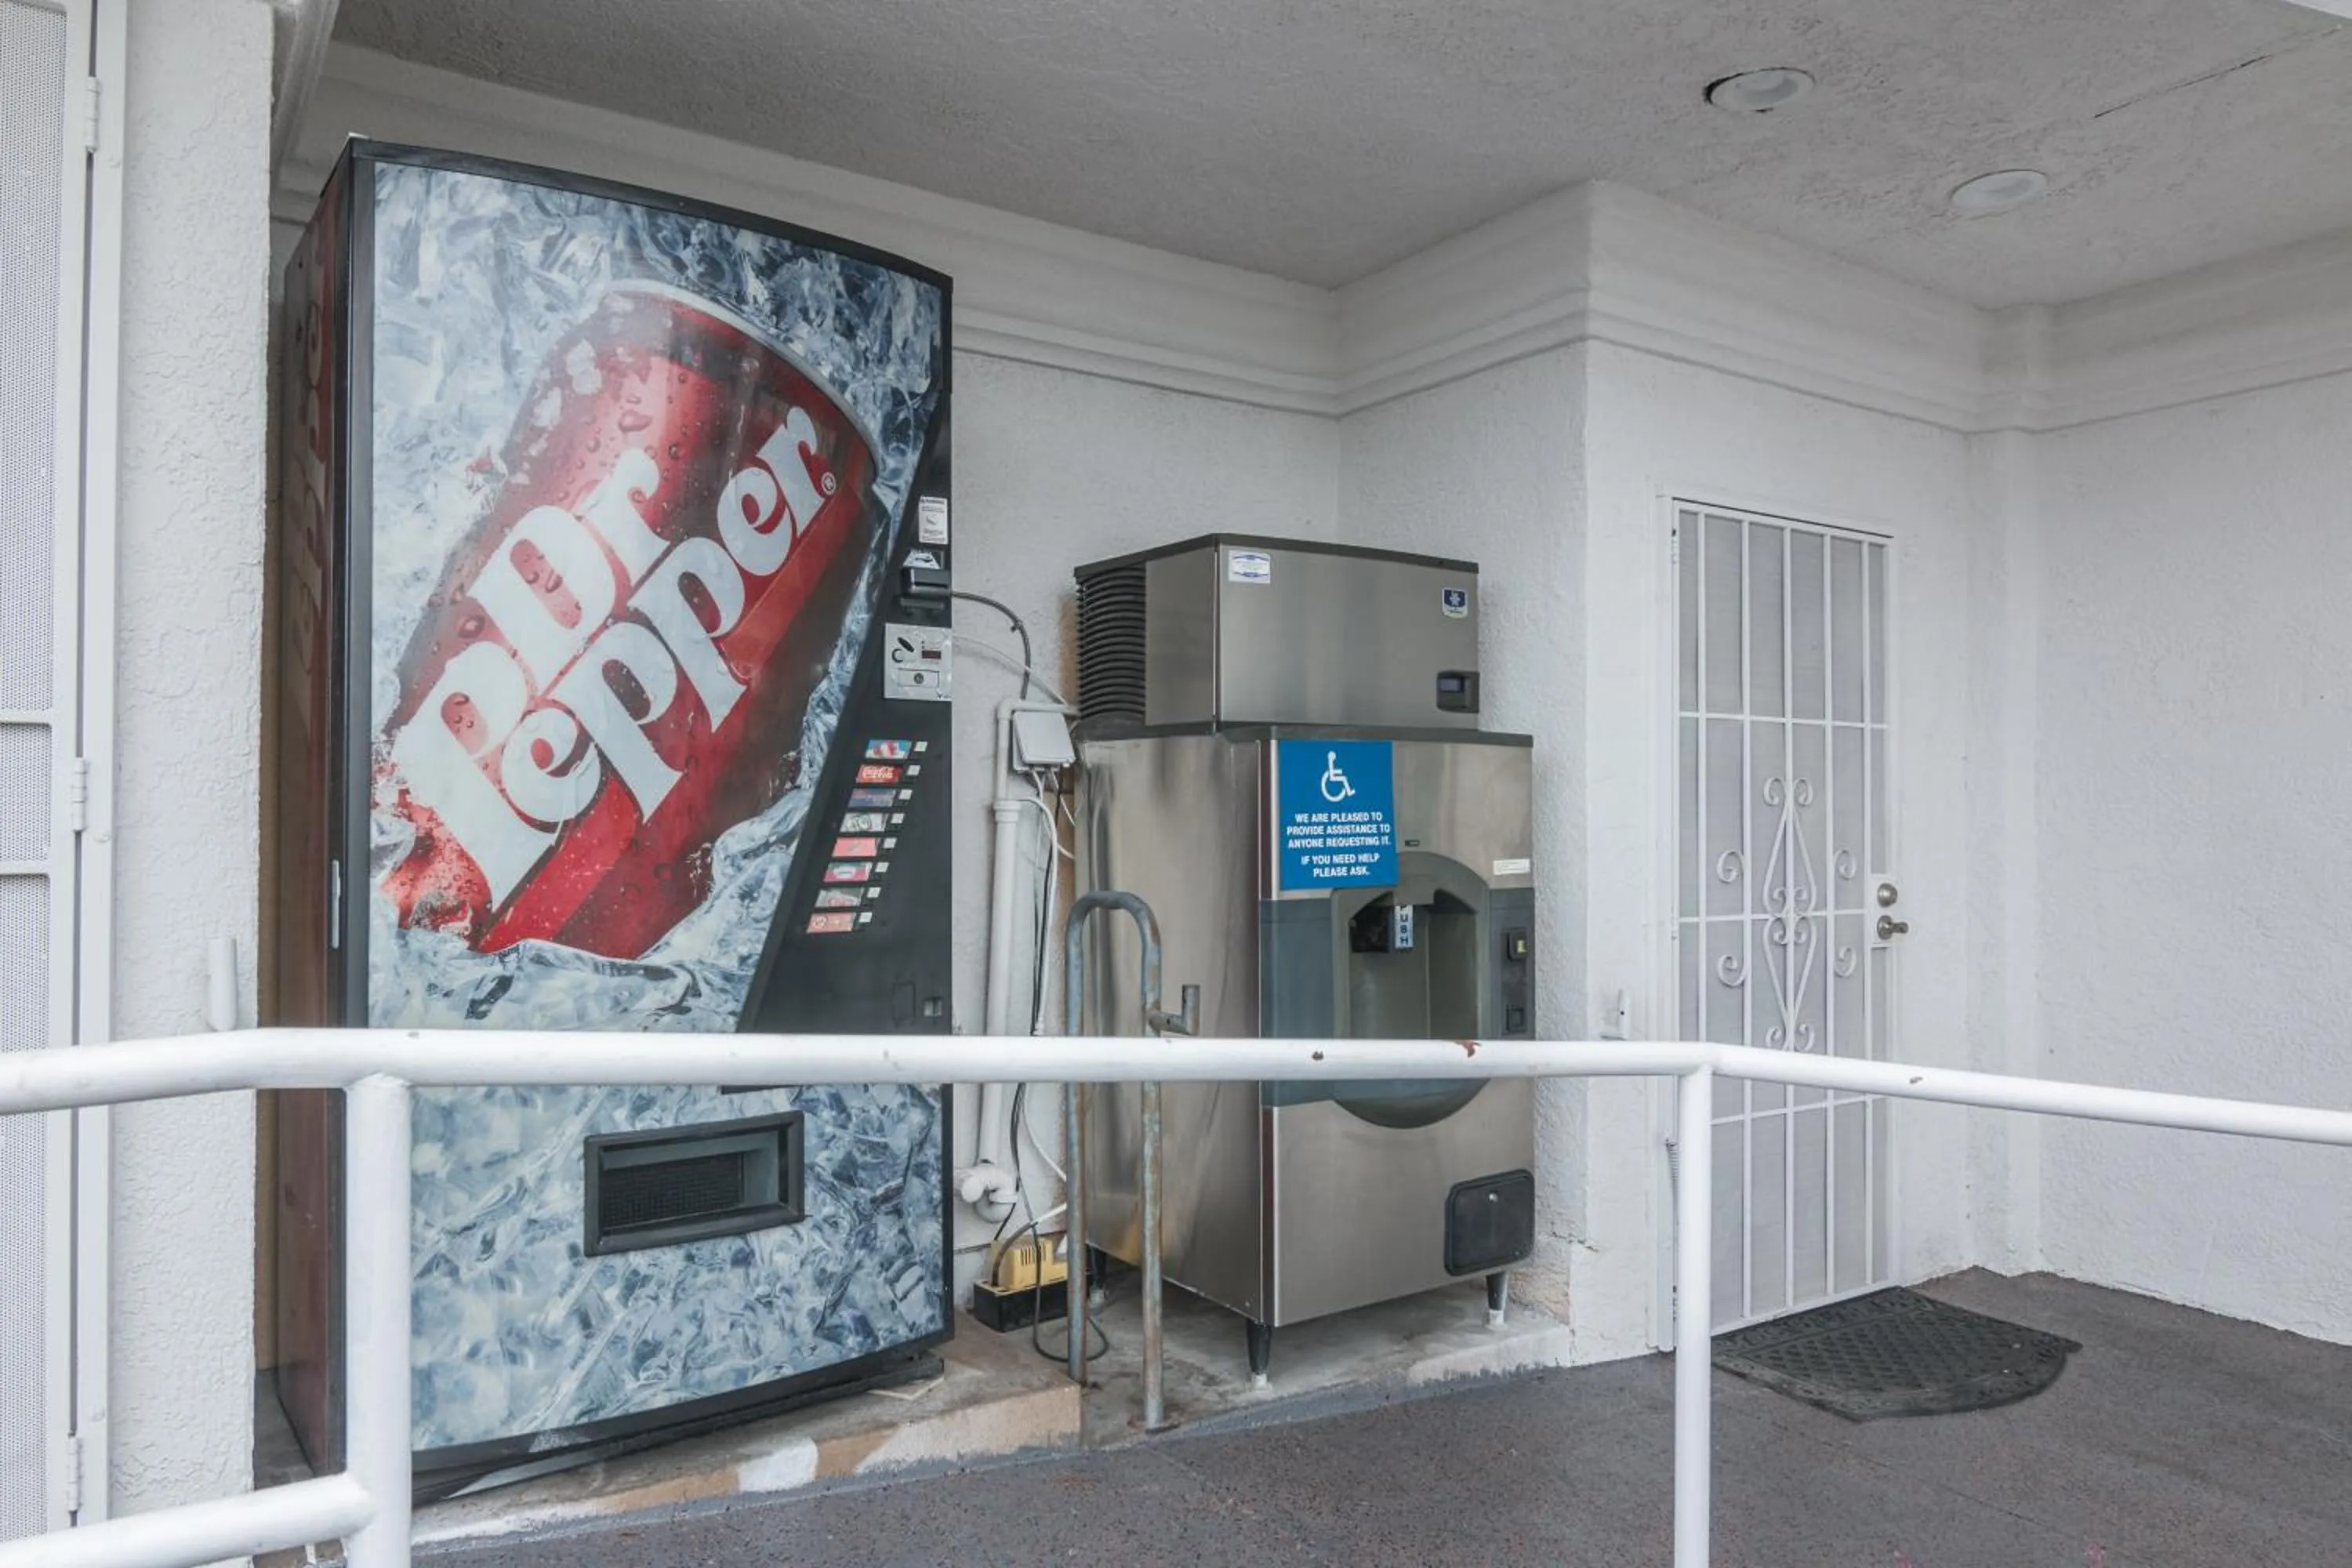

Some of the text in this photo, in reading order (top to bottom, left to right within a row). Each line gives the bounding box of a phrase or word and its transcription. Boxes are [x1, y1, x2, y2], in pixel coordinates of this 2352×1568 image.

[466, 448, 672, 699] Dr
[391, 406, 828, 911] Pepper
[1294, 811, 1383, 823] WE ARE PLEASED TO
[1287, 823, 1391, 836] PROVIDE ASSISTANCE TO
[1288, 835, 1392, 848] ANYONE REQUESTING IT.
[1301, 852, 1381, 866] IF YOU NEED HELP
[1312, 866, 1371, 878] PLEASE ASK.
[1399, 904, 1409, 946] PUSH
